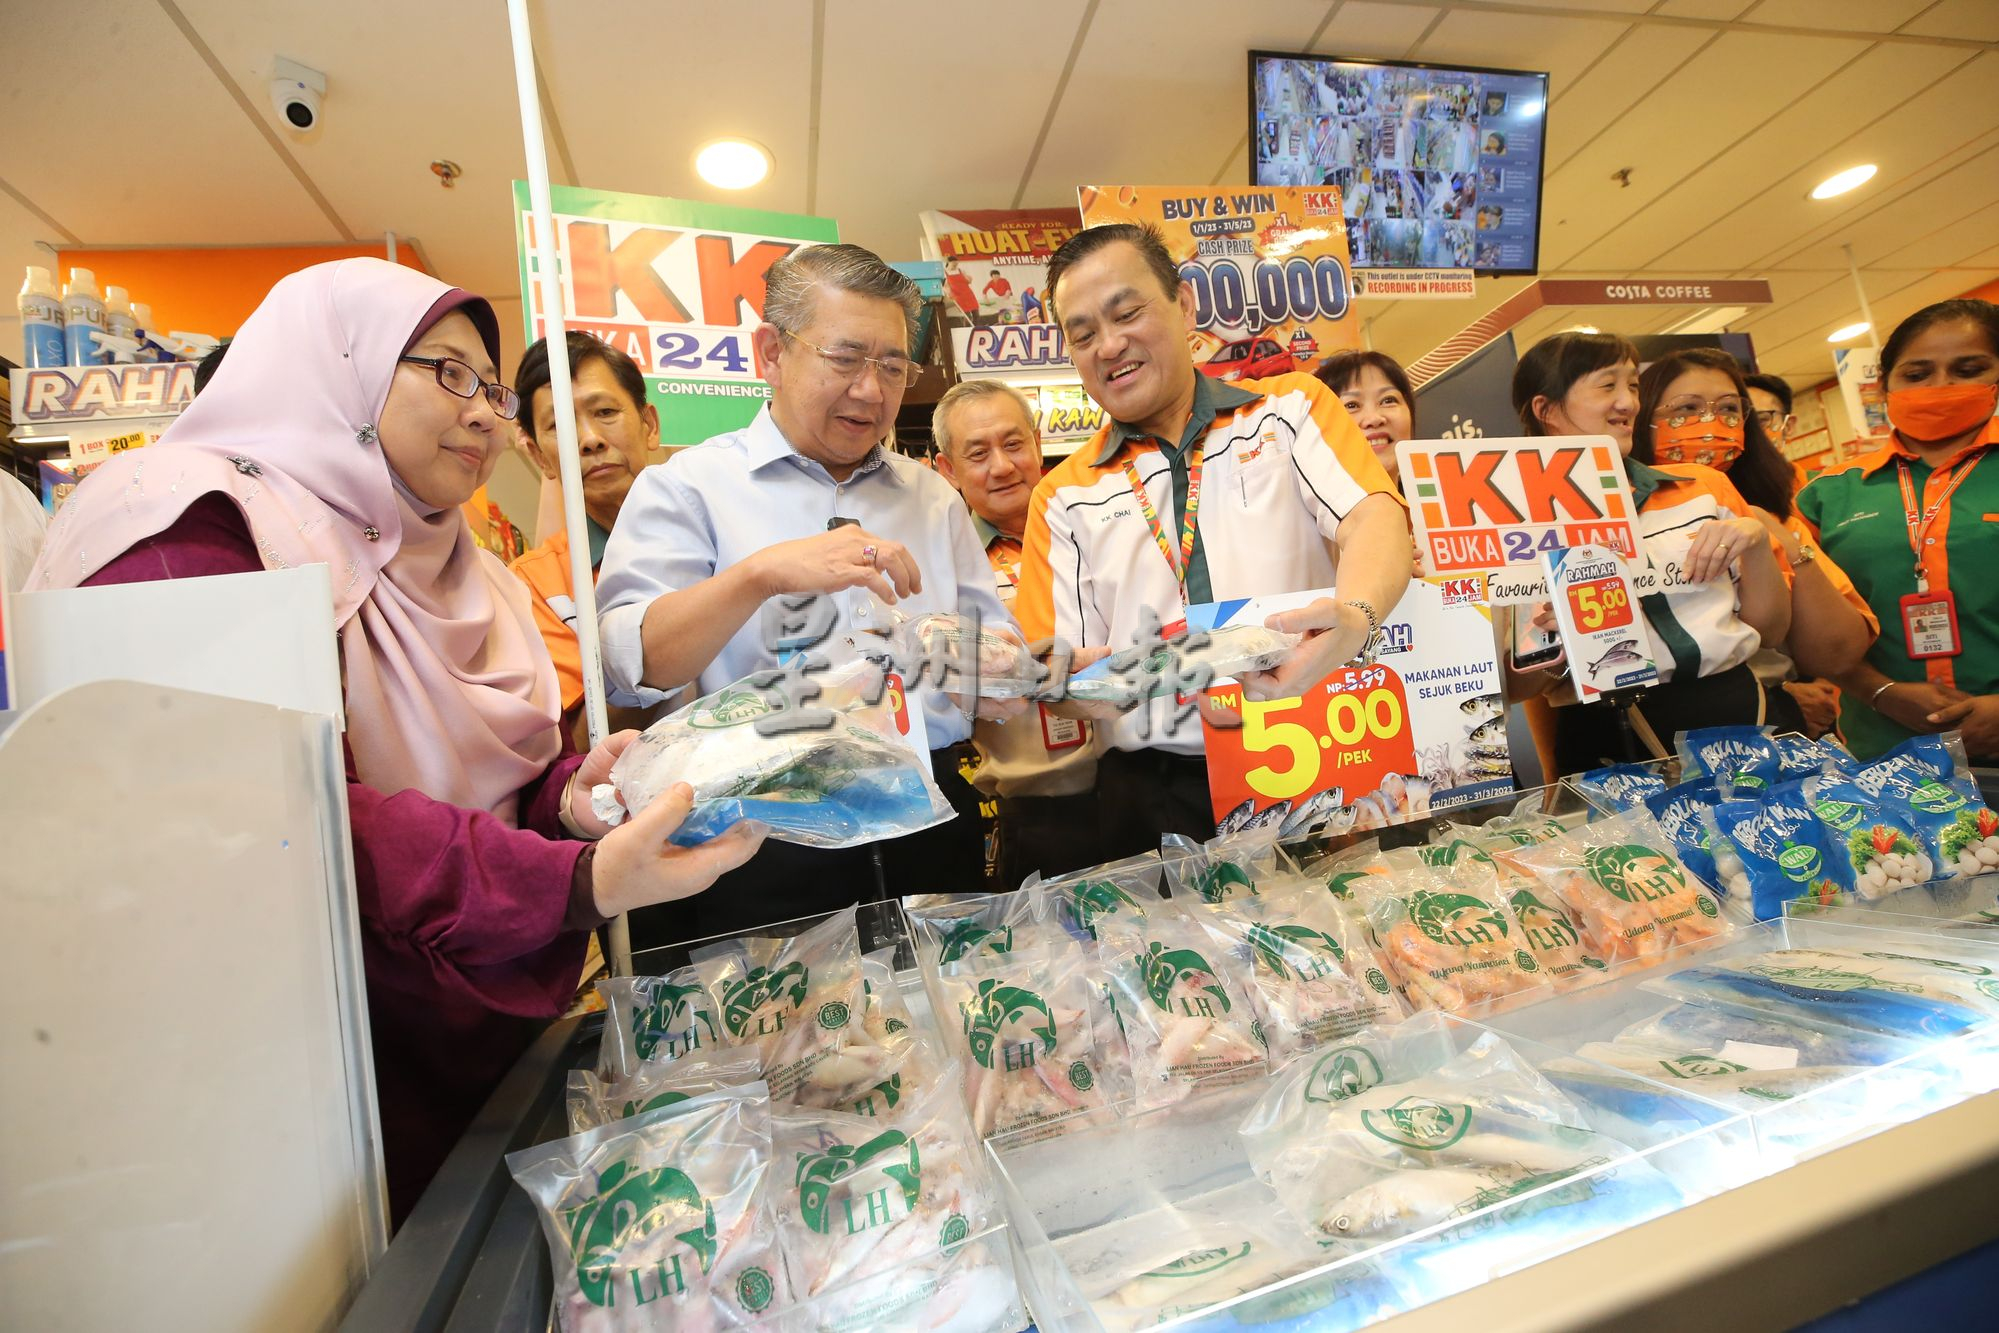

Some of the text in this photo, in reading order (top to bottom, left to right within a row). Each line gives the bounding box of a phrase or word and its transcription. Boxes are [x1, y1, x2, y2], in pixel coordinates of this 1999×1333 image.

[1162, 193, 1276, 220] BUY & WIN
[1308, 193, 1335, 208] KK
[1001, 221, 1036, 229] READY
[1193, 223, 1217, 234] 1/1/23
[1223, 220, 1253, 232] 31/5/23
[1198, 238, 1254, 255] CASH PRIZE
[992, 256, 1040, 266] ANYTIME,
[1367, 272, 1380, 281] This
[1380, 272, 1399, 281] outlet
[1406, 272, 1424, 281] under
[1424, 272, 1440, 281] CCTV
[1440, 272, 1473, 281] monitoring
[1368, 281, 1473, 294] RECORDING IN PROGRESS
[1606, 285, 1712, 300] COSTA COFFEE
[656, 332, 749, 373] 24
[657, 381, 773, 400] CONVENIENCE
[1048, 406, 1104, 433] KAW
[87, 441, 104, 450] BOX
[1188, 482, 1199, 501] KK
[1435, 448, 1604, 527] KK
[1434, 532, 1500, 564] BUKA
[1504, 529, 1566, 560] 24
[1566, 562, 1617, 583] RAHMAH
[1445, 578, 1477, 597] KK
[1578, 586, 1627, 628] 5.00
[1923, 644, 1942, 653] 0132
[1405, 661, 1494, 684] MAKANAN LAUT
[1419, 680, 1484, 699] SEJUK BEKU
[735, 709, 757, 720] LH
[1210, 687, 1402, 798] RM 5.00 /PEK
[1431, 796, 1469, 810] 22/2/2023
[1473, 785, 1513, 801] 31/3/2023
[1817, 804, 1849, 822] WAU
[1784, 847, 1811, 865] WAU
[1636, 875, 1675, 902] LH
[1450, 924, 1496, 946] LH
[1536, 925, 1571, 950] LH
[1294, 956, 1334, 982] LH
[824, 1008, 845, 1021] BEST
[1180, 997, 1217, 1019] LH
[669, 1024, 702, 1060] LH
[1004, 1041, 1036, 1073] LH
[773, 1066, 793, 1080] FOODS
[1073, 1070, 1089, 1081] BEST
[842, 1187, 891, 1235] LH
[630, 1254, 687, 1308] LH
